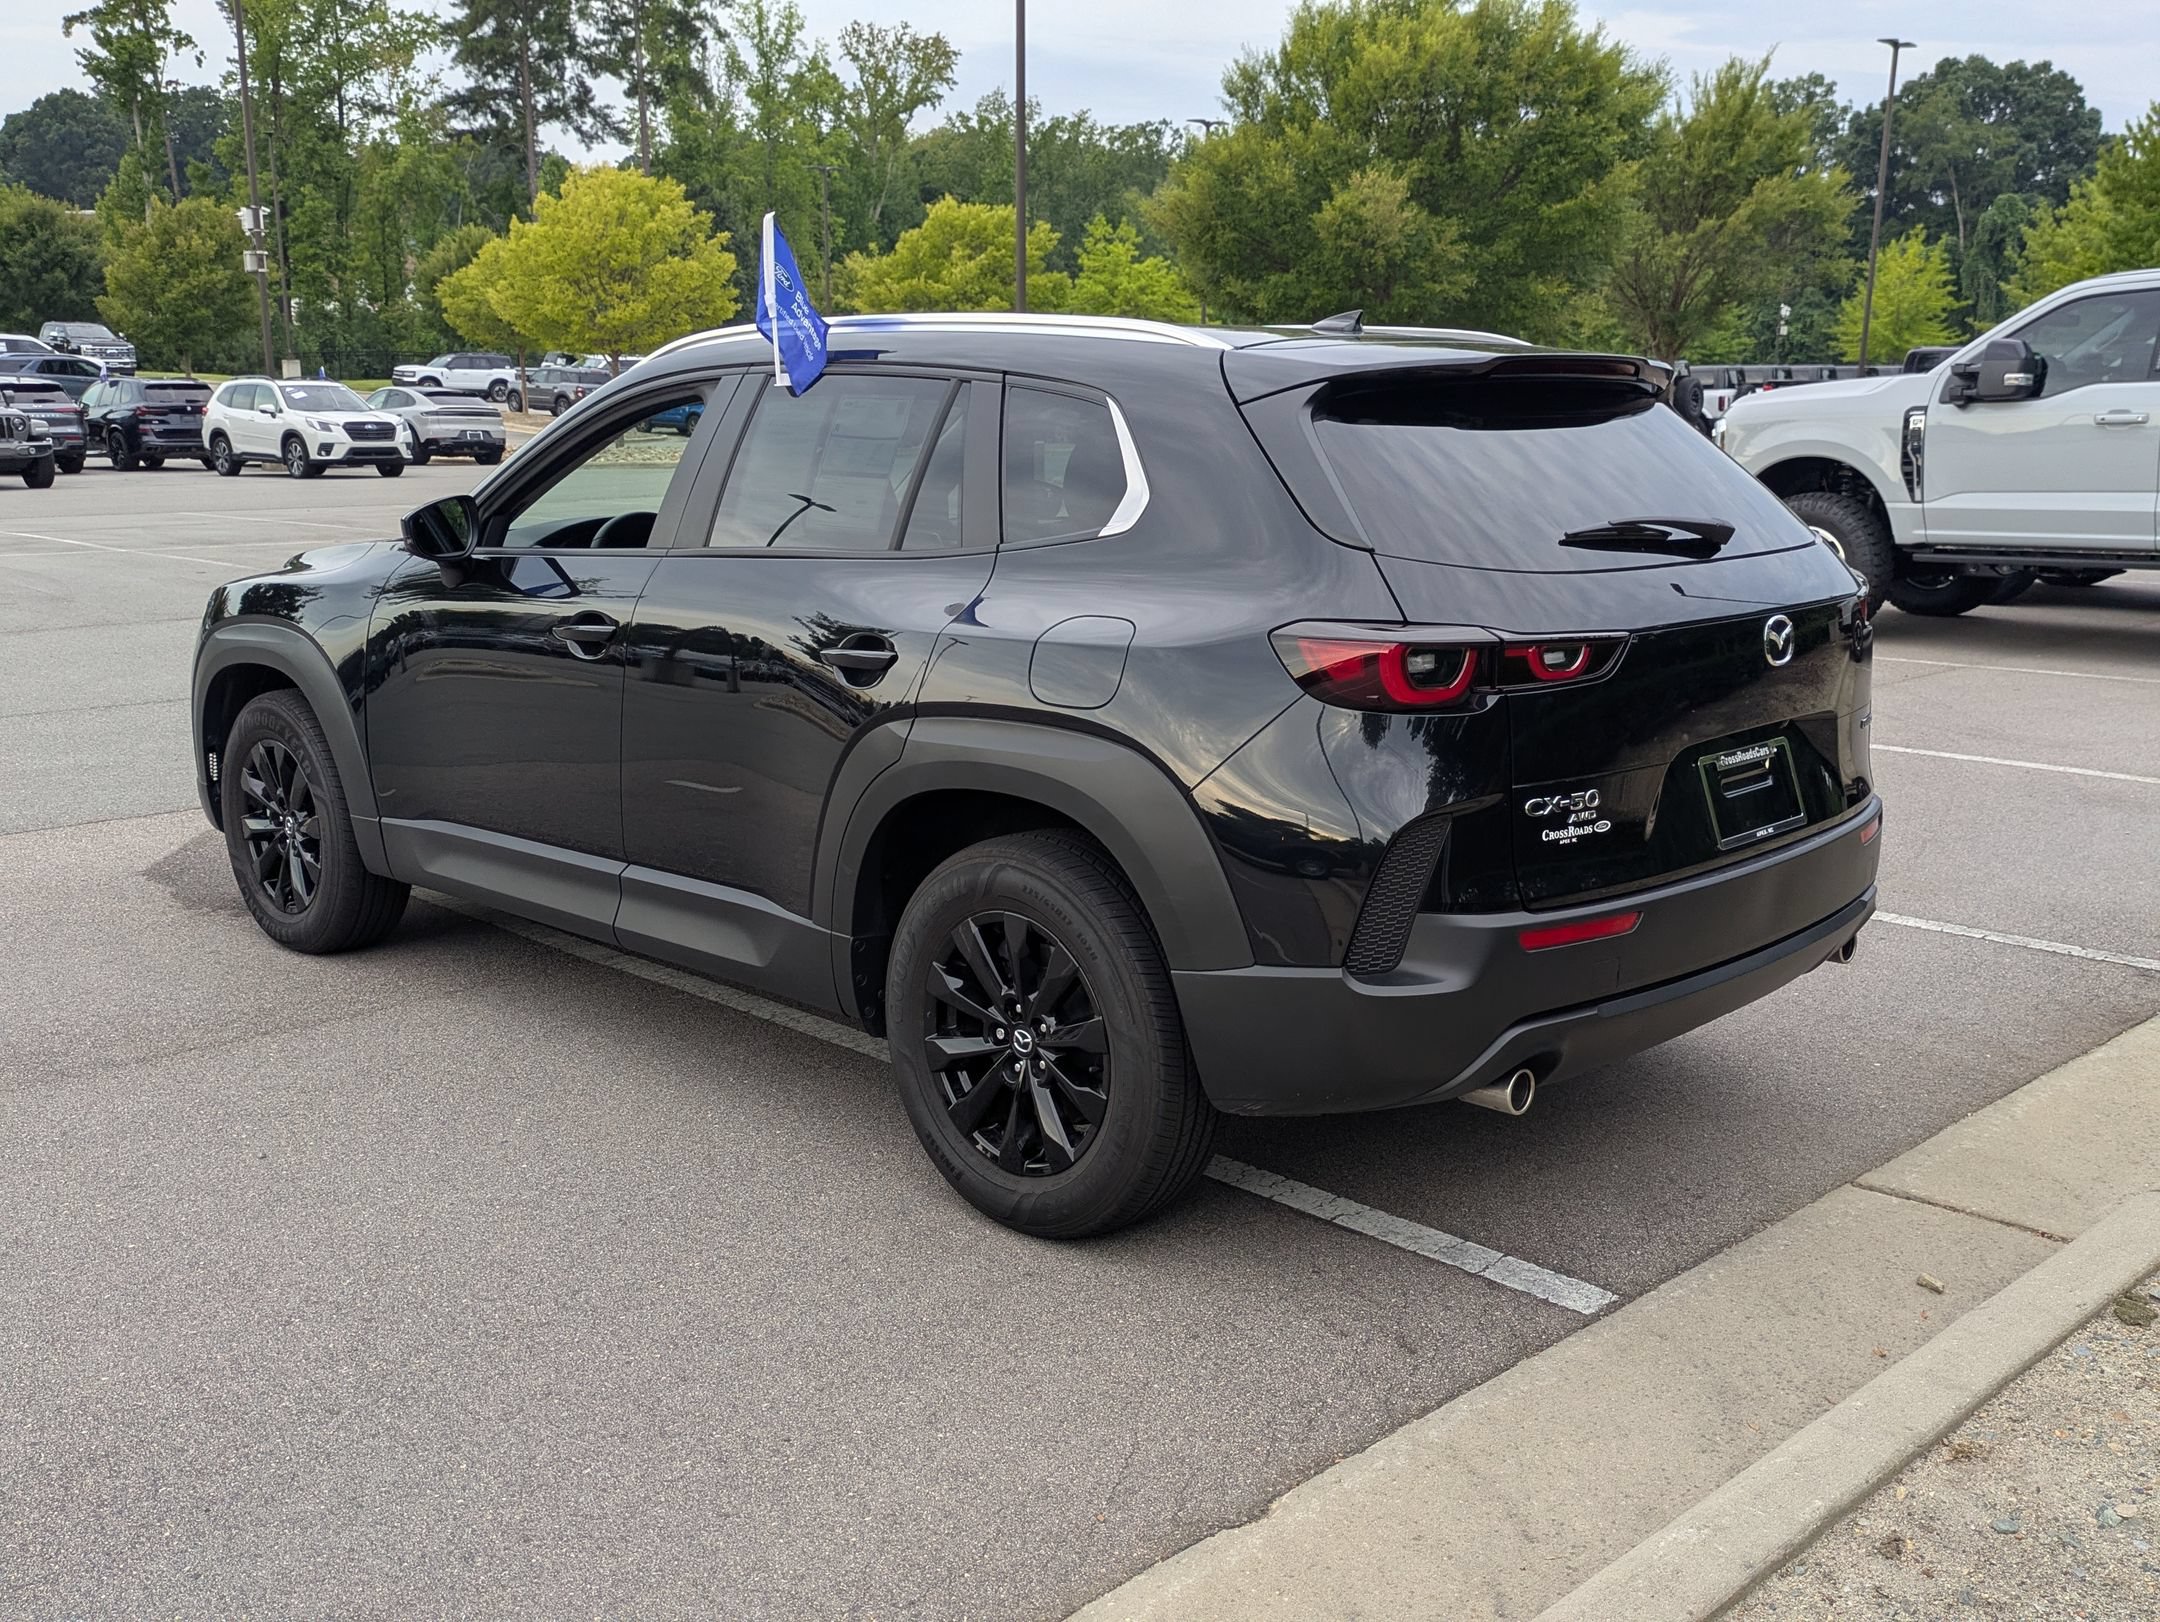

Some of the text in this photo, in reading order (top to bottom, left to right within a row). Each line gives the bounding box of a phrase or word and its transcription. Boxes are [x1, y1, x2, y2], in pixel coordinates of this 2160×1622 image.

[775, 264, 792, 289] Ford
[795, 291, 810, 316] Blue
[790, 302, 822, 351] Advantage
[1524, 788, 1600, 817] CX-50
[1567, 810, 1597, 823] AWD
